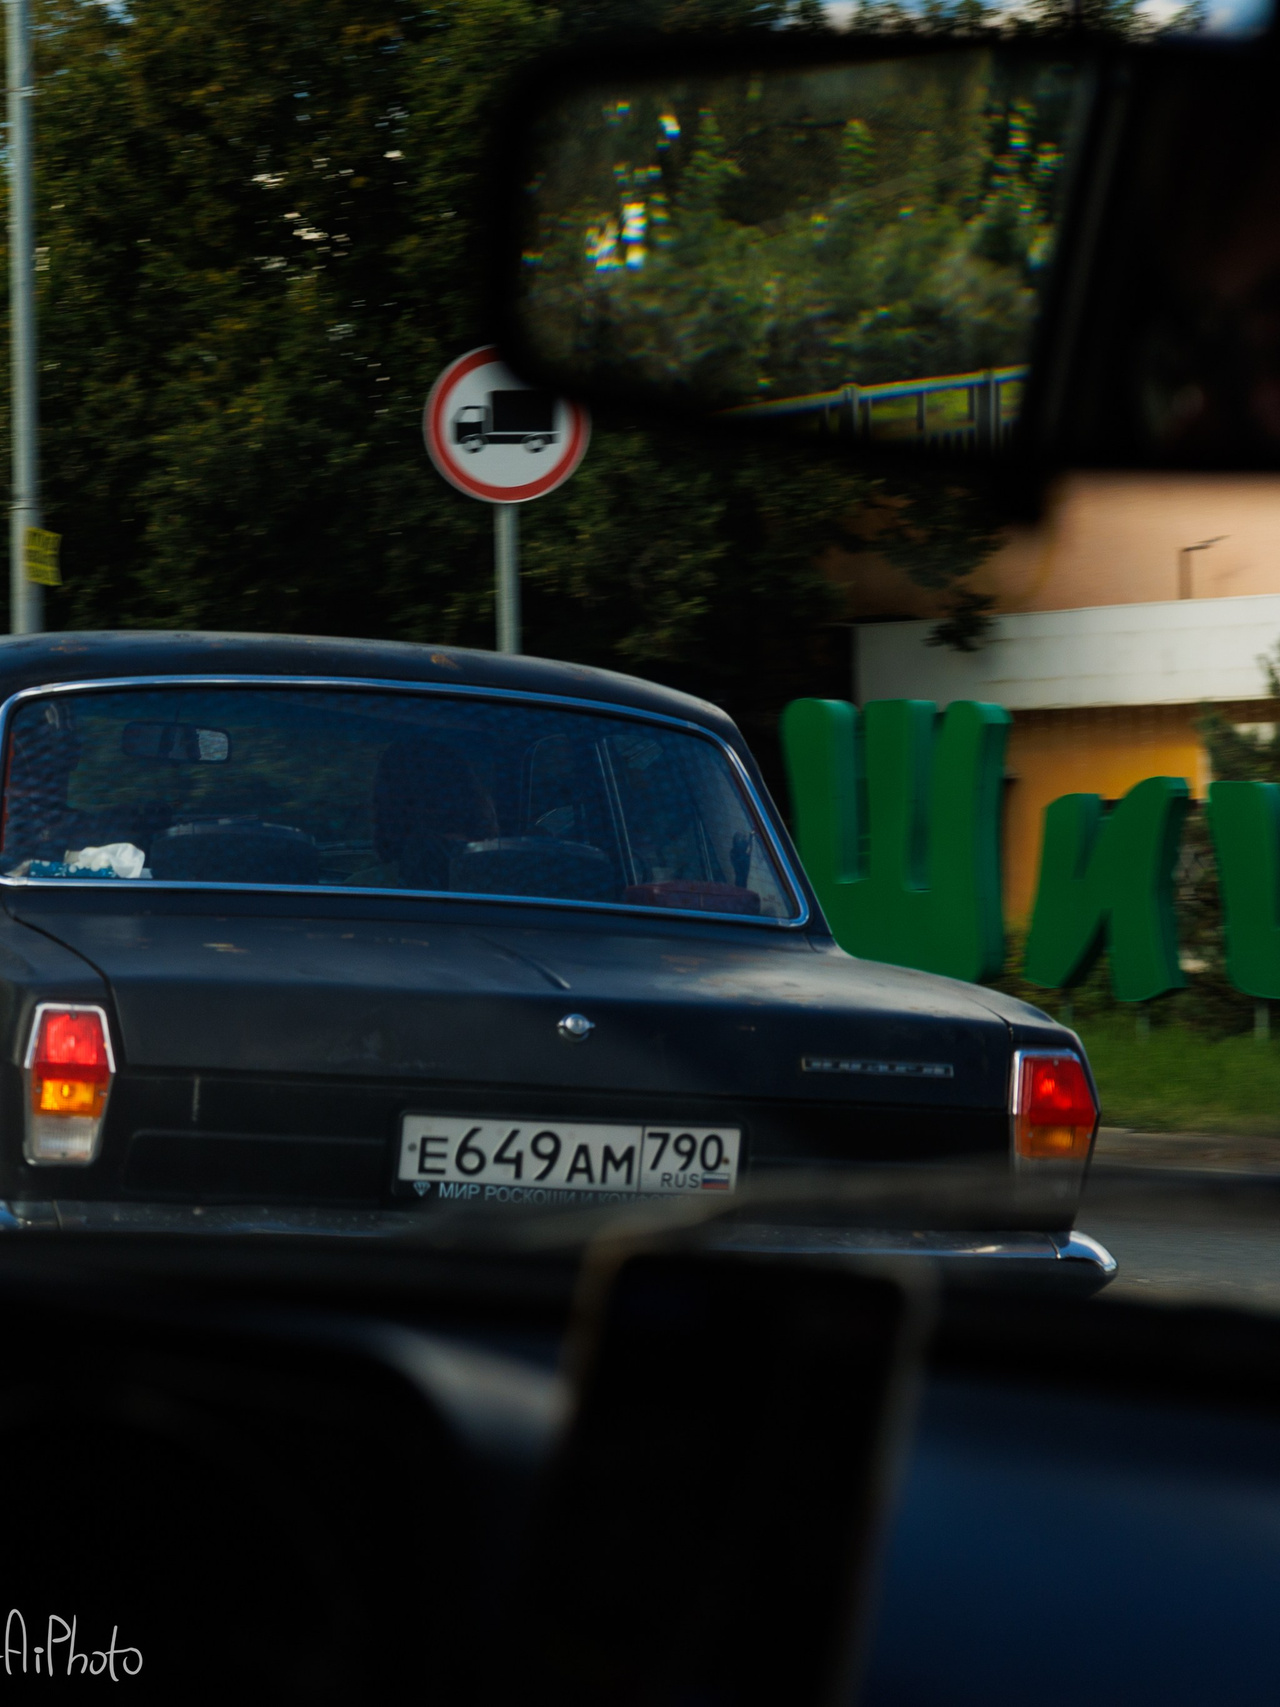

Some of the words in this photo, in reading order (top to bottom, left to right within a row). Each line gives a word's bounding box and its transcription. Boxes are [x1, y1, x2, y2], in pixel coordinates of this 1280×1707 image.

[418, 1127, 637, 1186] Е649АМ
[647, 1131, 724, 1172] 790
[660, 1172, 700, 1189] RUS
[439, 1182, 480, 1200] МИР
[484, 1185, 577, 1205] РОСКОШИ
